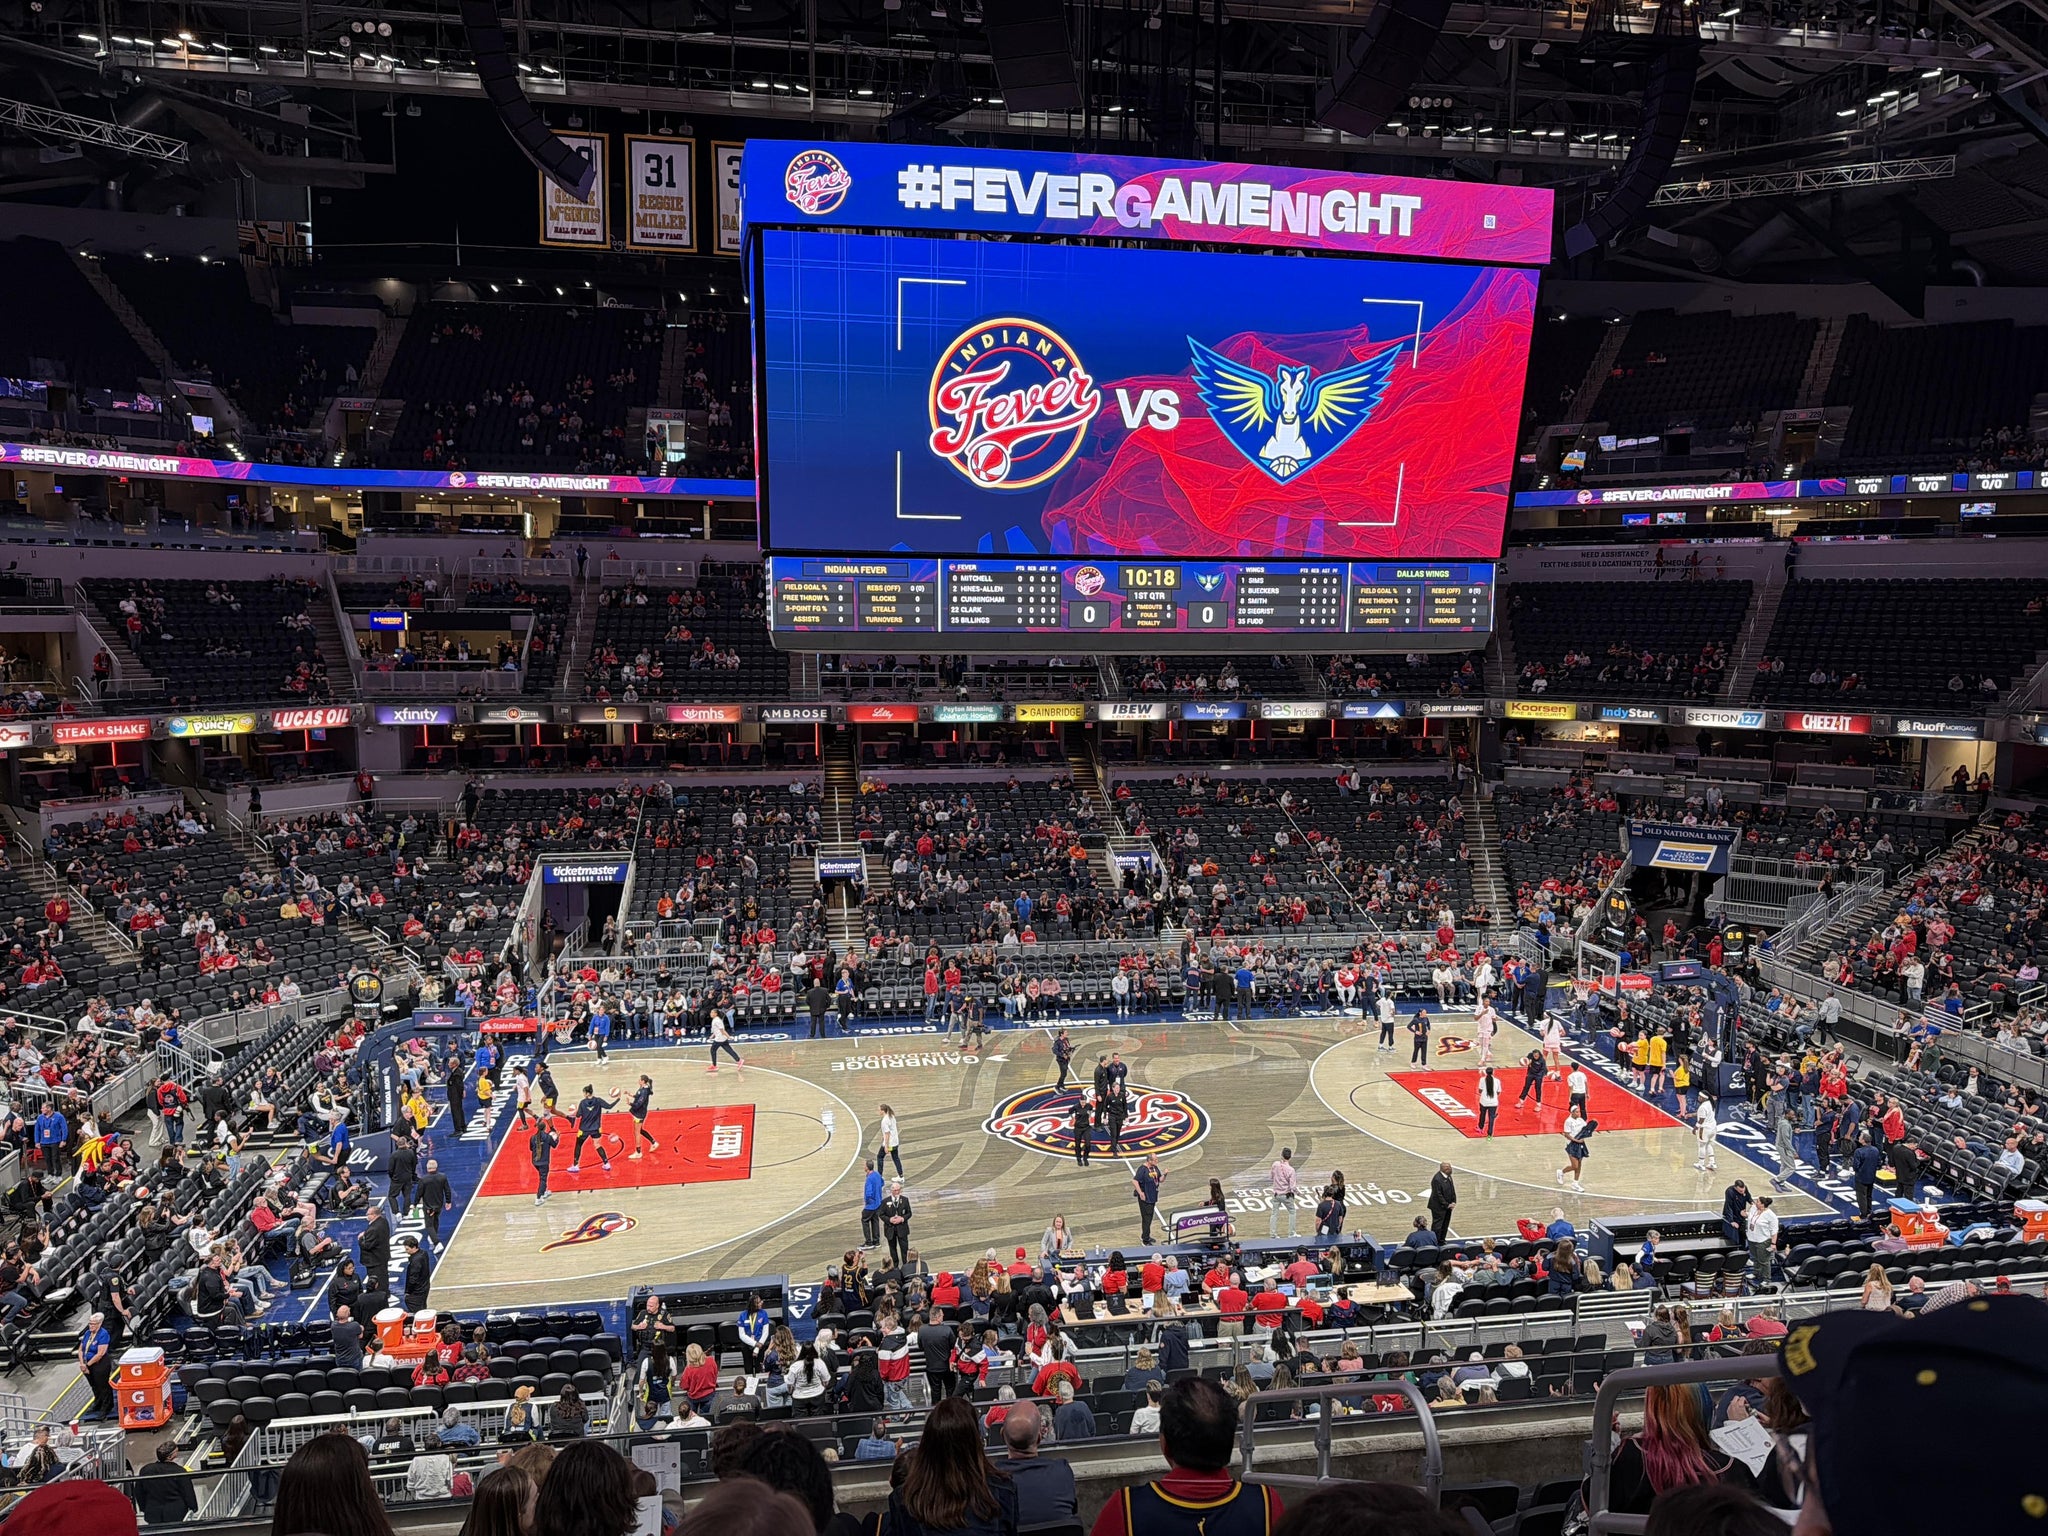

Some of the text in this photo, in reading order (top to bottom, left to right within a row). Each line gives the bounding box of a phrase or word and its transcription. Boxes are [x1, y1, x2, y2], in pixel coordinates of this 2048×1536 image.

[793, 154, 837, 170] INDIANA
[645, 154, 676, 188] 31
[786, 165, 852, 202] Fever
[639, 194, 684, 211] REGGIE
[898, 164, 1421, 237] #FEVERGAMENIGHT
[636, 212, 687, 230] MILLER
[951, 329, 1067, 373] INDIANA
[930, 360, 1101, 457] Fever
[1116, 388, 1180, 430] VS
[21, 448, 180, 472] #FEVERGAMENIGHT
[477, 475, 610, 490] #FEVERGAMENIGHT
[1918, 482, 1939, 492] 0/0
[1981, 479, 2002, 490] 0/0
[1602, 486, 1732, 502] #FEVERGAMENIGHT
[1858, 484, 1878, 494] 0/0
[1581, 550, 1650, 558] NEED ASSISTANCE?
[824, 565, 887, 574] INDIANA FEVER
[960, 575, 993, 583] MITCHELL
[1125, 569, 1175, 586] 10:18
[915, 585, 925, 593] (0)
[1134, 592, 1165, 600] 1ST QTR
[865, 616, 903, 624] TURNOVERS
[1083, 606, 1095, 623] 0
[1202, 607, 1214, 623] 0
[698, 708, 724, 719] mhs
[762, 709, 828, 718] AMBROSE
[872, 708, 894, 719] Lilly
[943, 705, 994, 713] Peyton Manning
[1030, 706, 1081, 717] GAINBRIDGE
[1112, 704, 1154, 714] IBEW
[1206, 705, 1231, 716] Kroger
[1262, 703, 1326, 718] aes Indiana
[1511, 703, 1567, 714] Koorsen
[200, 714, 225, 722] SOUR
[273, 708, 349, 728] LUCAS OIL
[393, 708, 438, 723] xfinity
[1687, 711, 1759, 725] SECTION 127
[56, 724, 147, 738] STEAK SHAKE
[193, 719, 233, 732] PUNCH
[1912, 721, 1946, 732] Ruoff
[1644, 827, 1731, 841] OLD NATIONAL BANK
[552, 865, 619, 876] ticketmaster
[820, 861, 861, 871] ticketmaster
[831, 1055, 980, 1071] GAINBRIDGE
[384, 1091, 392, 1103] YOU
[1187, 1214, 1227, 1228] CareSource
[2034, 1212, 2042, 1221] G
[440, 1349, 453, 1359] 22
[130, 1365, 143, 1377] G
[131, 1390, 145, 1404] G
